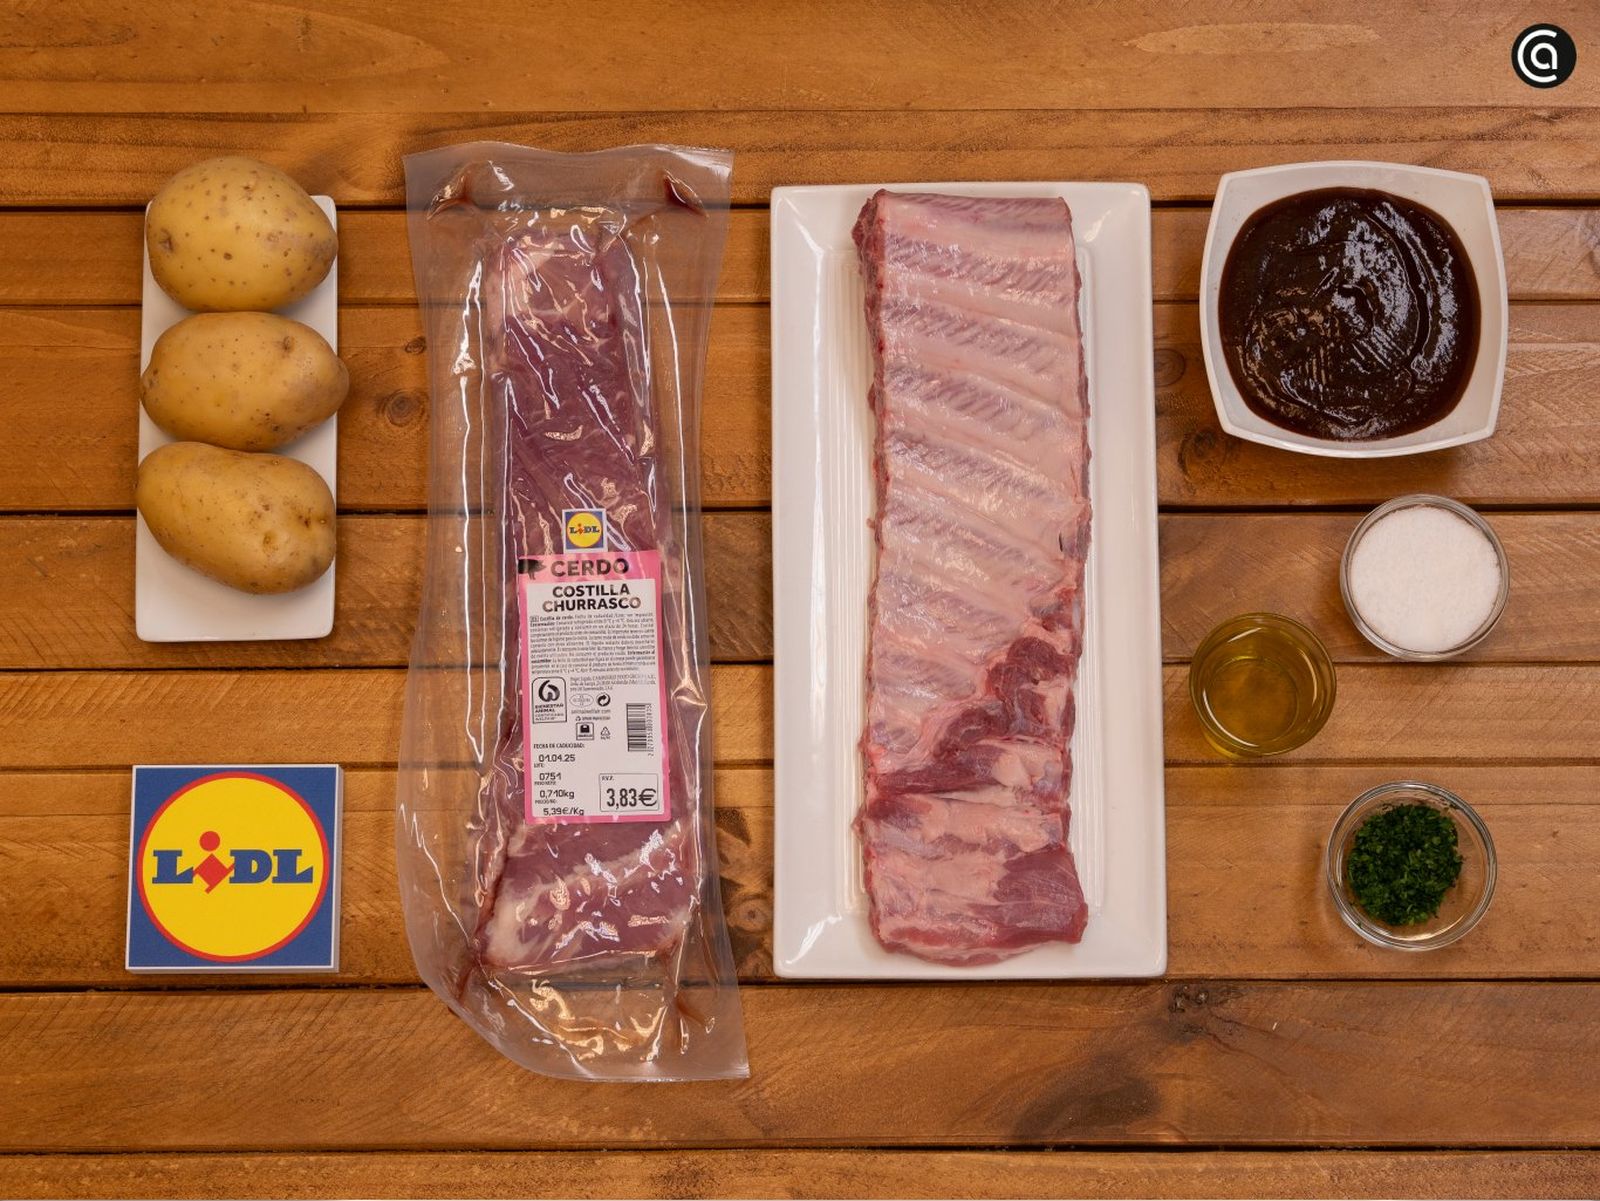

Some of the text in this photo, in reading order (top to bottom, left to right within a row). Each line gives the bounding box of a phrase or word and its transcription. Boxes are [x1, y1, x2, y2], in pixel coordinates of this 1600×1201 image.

[550, 558, 629, 577] CERDO
[552, 583, 631, 598] COSTILLA
[542, 597, 642, 612] CHURRASCO
[538, 753, 576, 762] 01.04.25
[539, 772, 562, 781] 0751
[539, 789, 575, 799] 0,710kg
[606, 788, 658, 810] 3,83€
[543, 806, 584, 816] 5,39€/Kg
